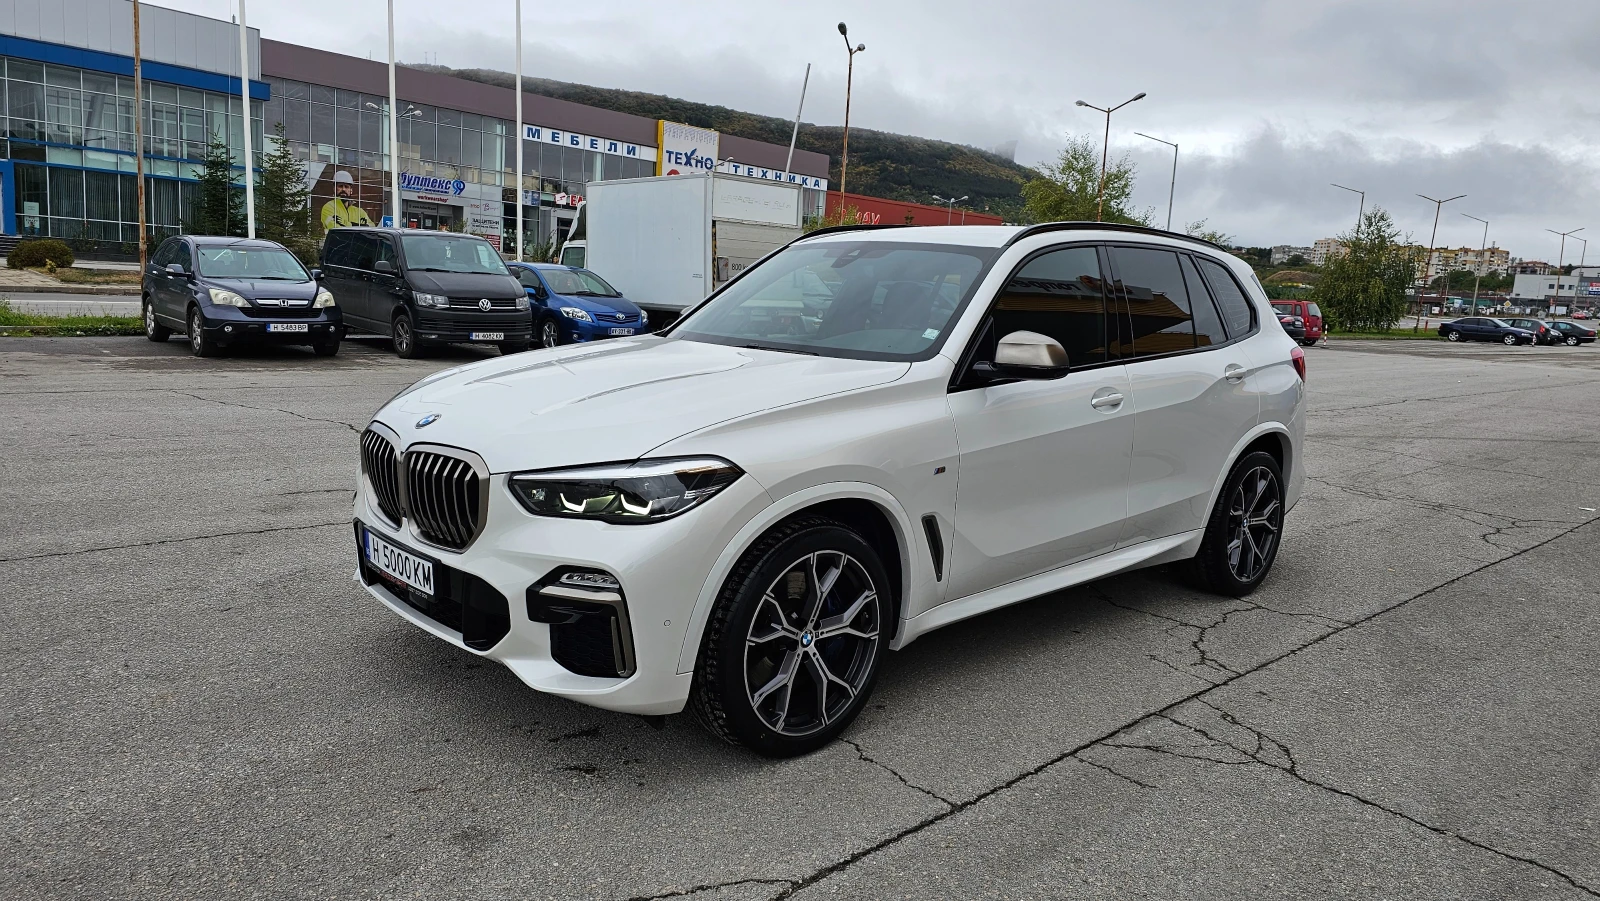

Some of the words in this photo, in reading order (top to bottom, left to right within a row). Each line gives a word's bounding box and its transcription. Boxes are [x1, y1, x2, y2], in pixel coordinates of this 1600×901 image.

[526, 126, 637, 156] МЕБЕЛИ
[665, 148, 714, 170] ТЕХНО
[732, 164, 821, 188] ТЕХНИКА
[372, 537, 380, 564] H
